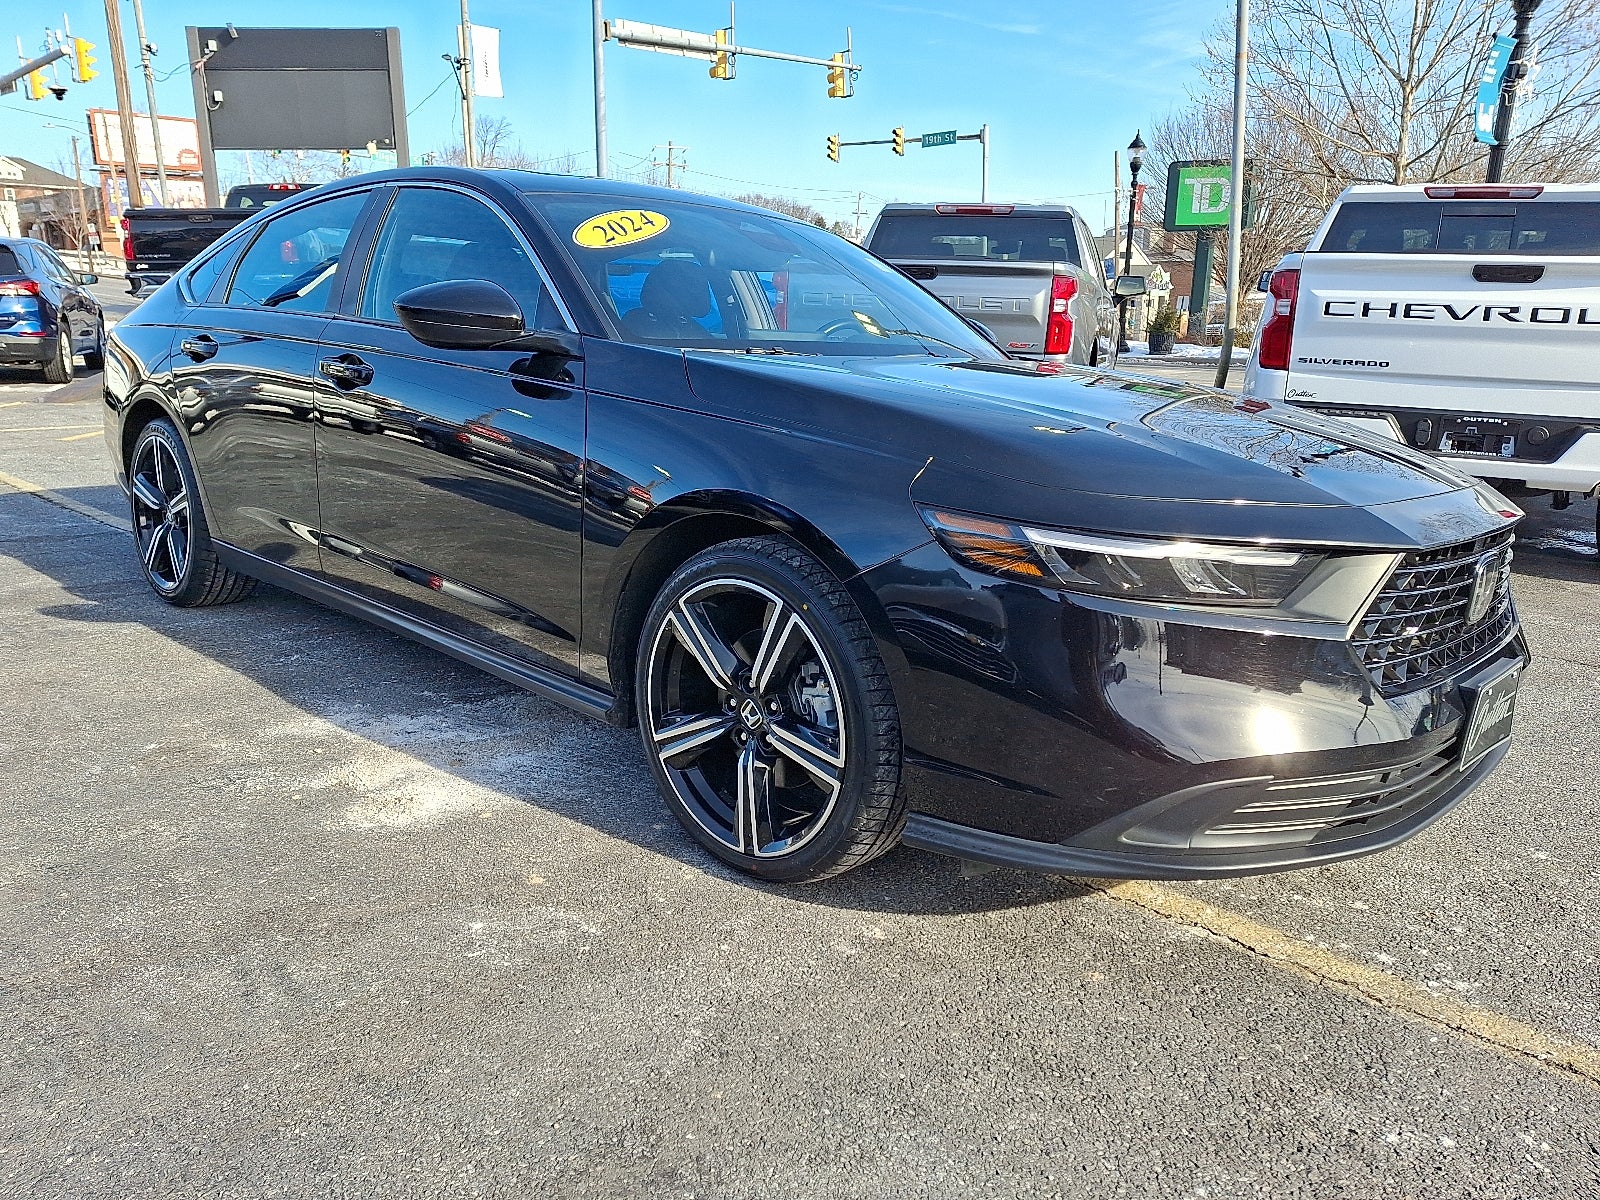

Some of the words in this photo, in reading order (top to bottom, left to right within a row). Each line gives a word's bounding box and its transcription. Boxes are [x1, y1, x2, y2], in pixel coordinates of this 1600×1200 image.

[925, 135, 942, 144] 19th
[944, 133, 954, 142] St
[1184, 177, 1232, 214] TD
[592, 211, 656, 243] 2024
[1297, 357, 1390, 368] SILVERADO
